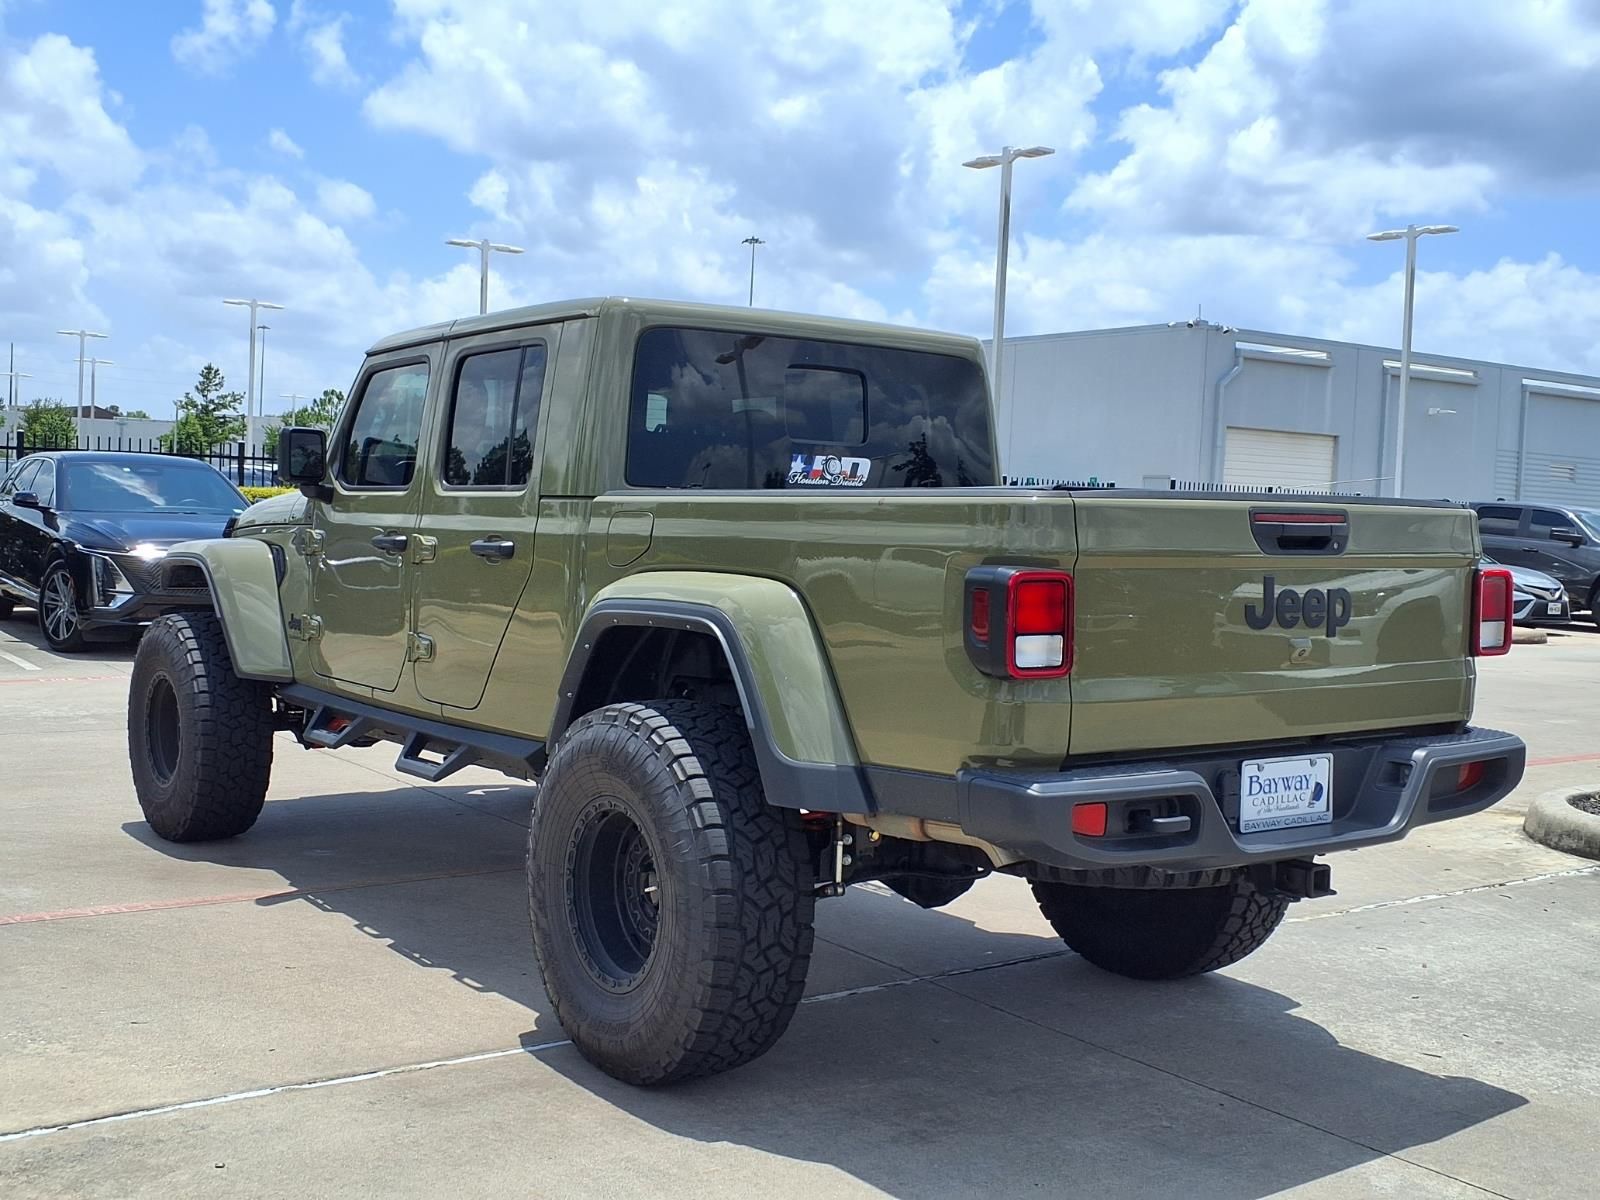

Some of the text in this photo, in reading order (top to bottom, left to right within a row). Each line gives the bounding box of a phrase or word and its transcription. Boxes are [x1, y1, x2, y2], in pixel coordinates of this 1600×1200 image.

[789, 472, 864, 487] Houston Diesels
[1244, 576, 1352, 637] Jeep
[1247, 774, 1312, 796] Bayway
[1252, 792, 1306, 807] CADILLAC
[1244, 814, 1329, 831] BAYWAY CADILLAC
